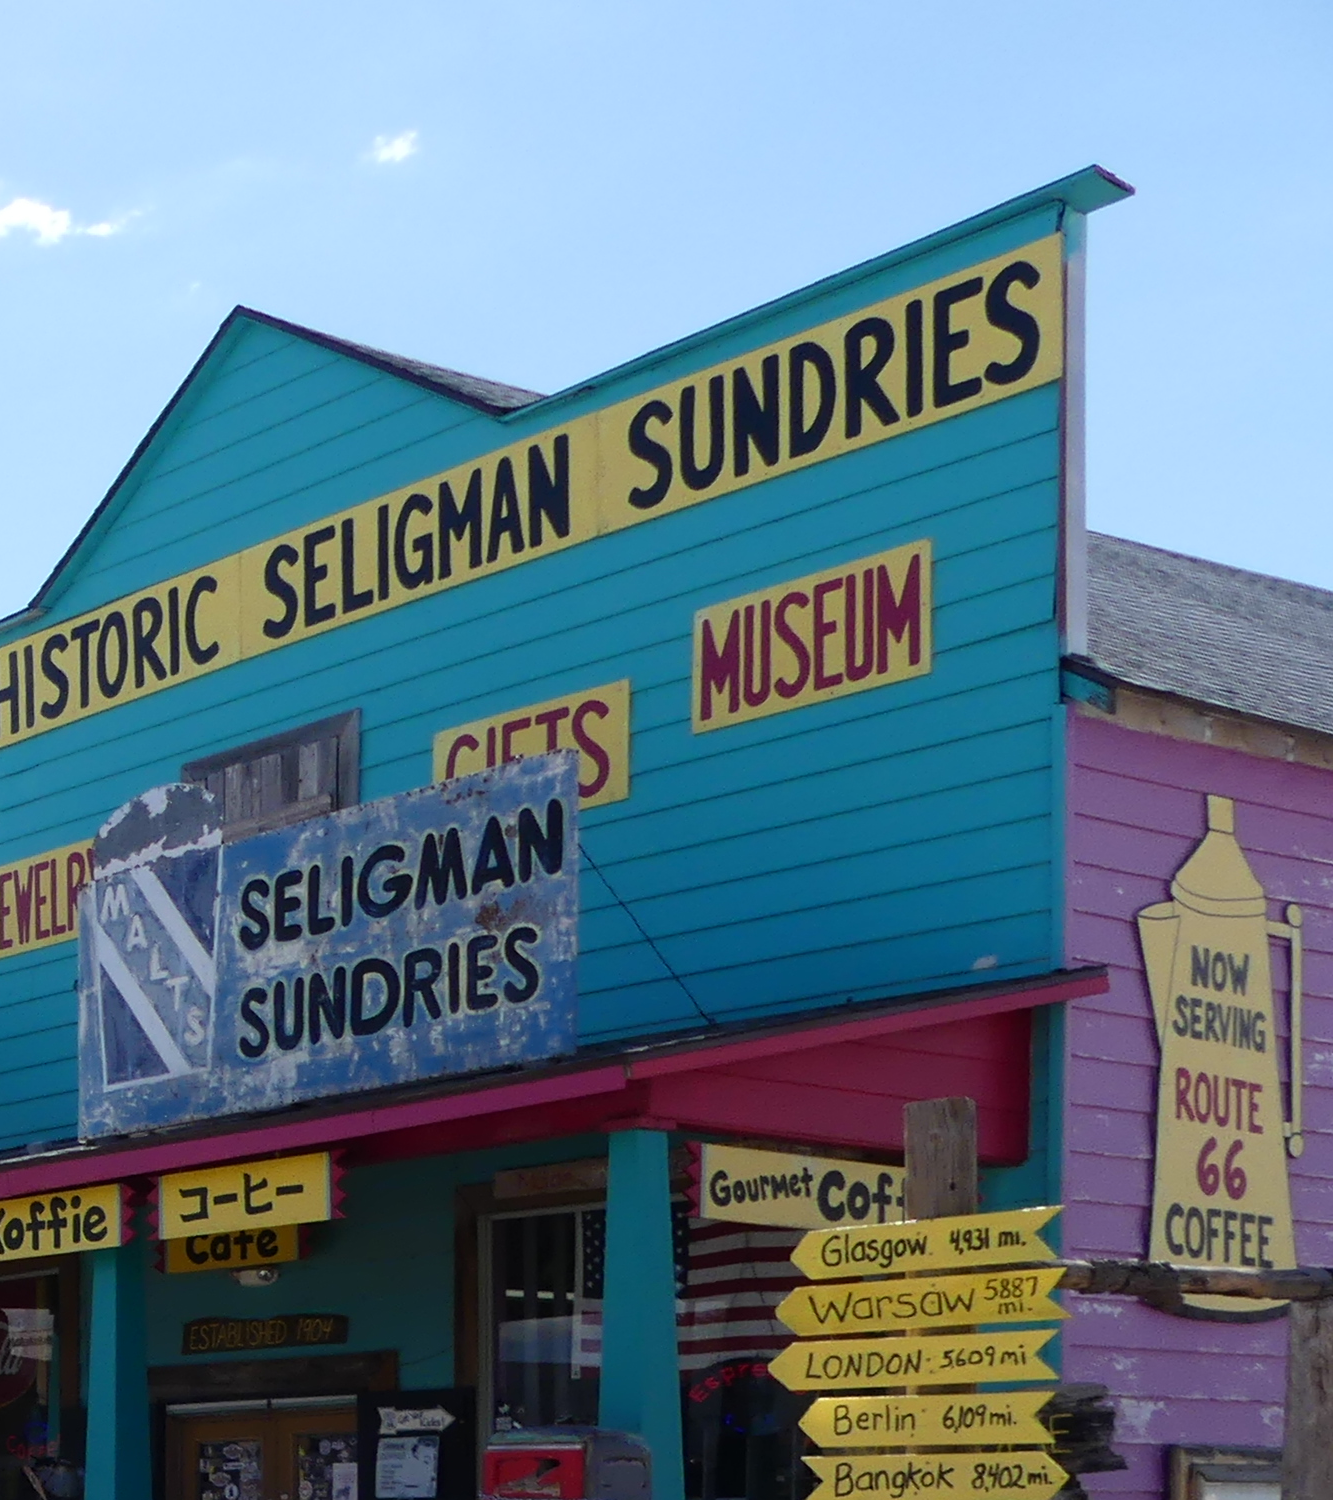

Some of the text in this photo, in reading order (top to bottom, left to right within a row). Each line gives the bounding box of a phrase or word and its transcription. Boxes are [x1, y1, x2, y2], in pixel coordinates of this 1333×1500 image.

[262, 433, 571, 640] SELIGMAN
[627, 261, 1041, 509] SUNDRIES
[700, 553, 921, 721] MUSEUM
[239, 798, 564, 951] SELIGMAN
[100, 886, 206, 1047] MALTS
[239, 927, 539, 1058] SUNDRIES
[1191, 944, 1250, 996] NOW
[1172, 996, 1267, 1053] SERVING
[1175, 1067, 1264, 1135] ROUTE
[709, 1167, 814, 1207] Gourmet
[1197, 1137, 1247, 1200] 66
[179, 1173, 304, 1222] コーヒー
[821, 1234, 928, 1268] Glasgow
[1165, 1202, 1273, 1269] COFFEE
[808, 1276, 1039, 1325] Warsaw 5887
[190, 1318, 334, 1350] ESTABLISHED 1904
[805, 1350, 923, 1380] LONDON
[834, 1406, 916, 1435] Berlin
[835, 1463, 955, 1499] Bangkok
